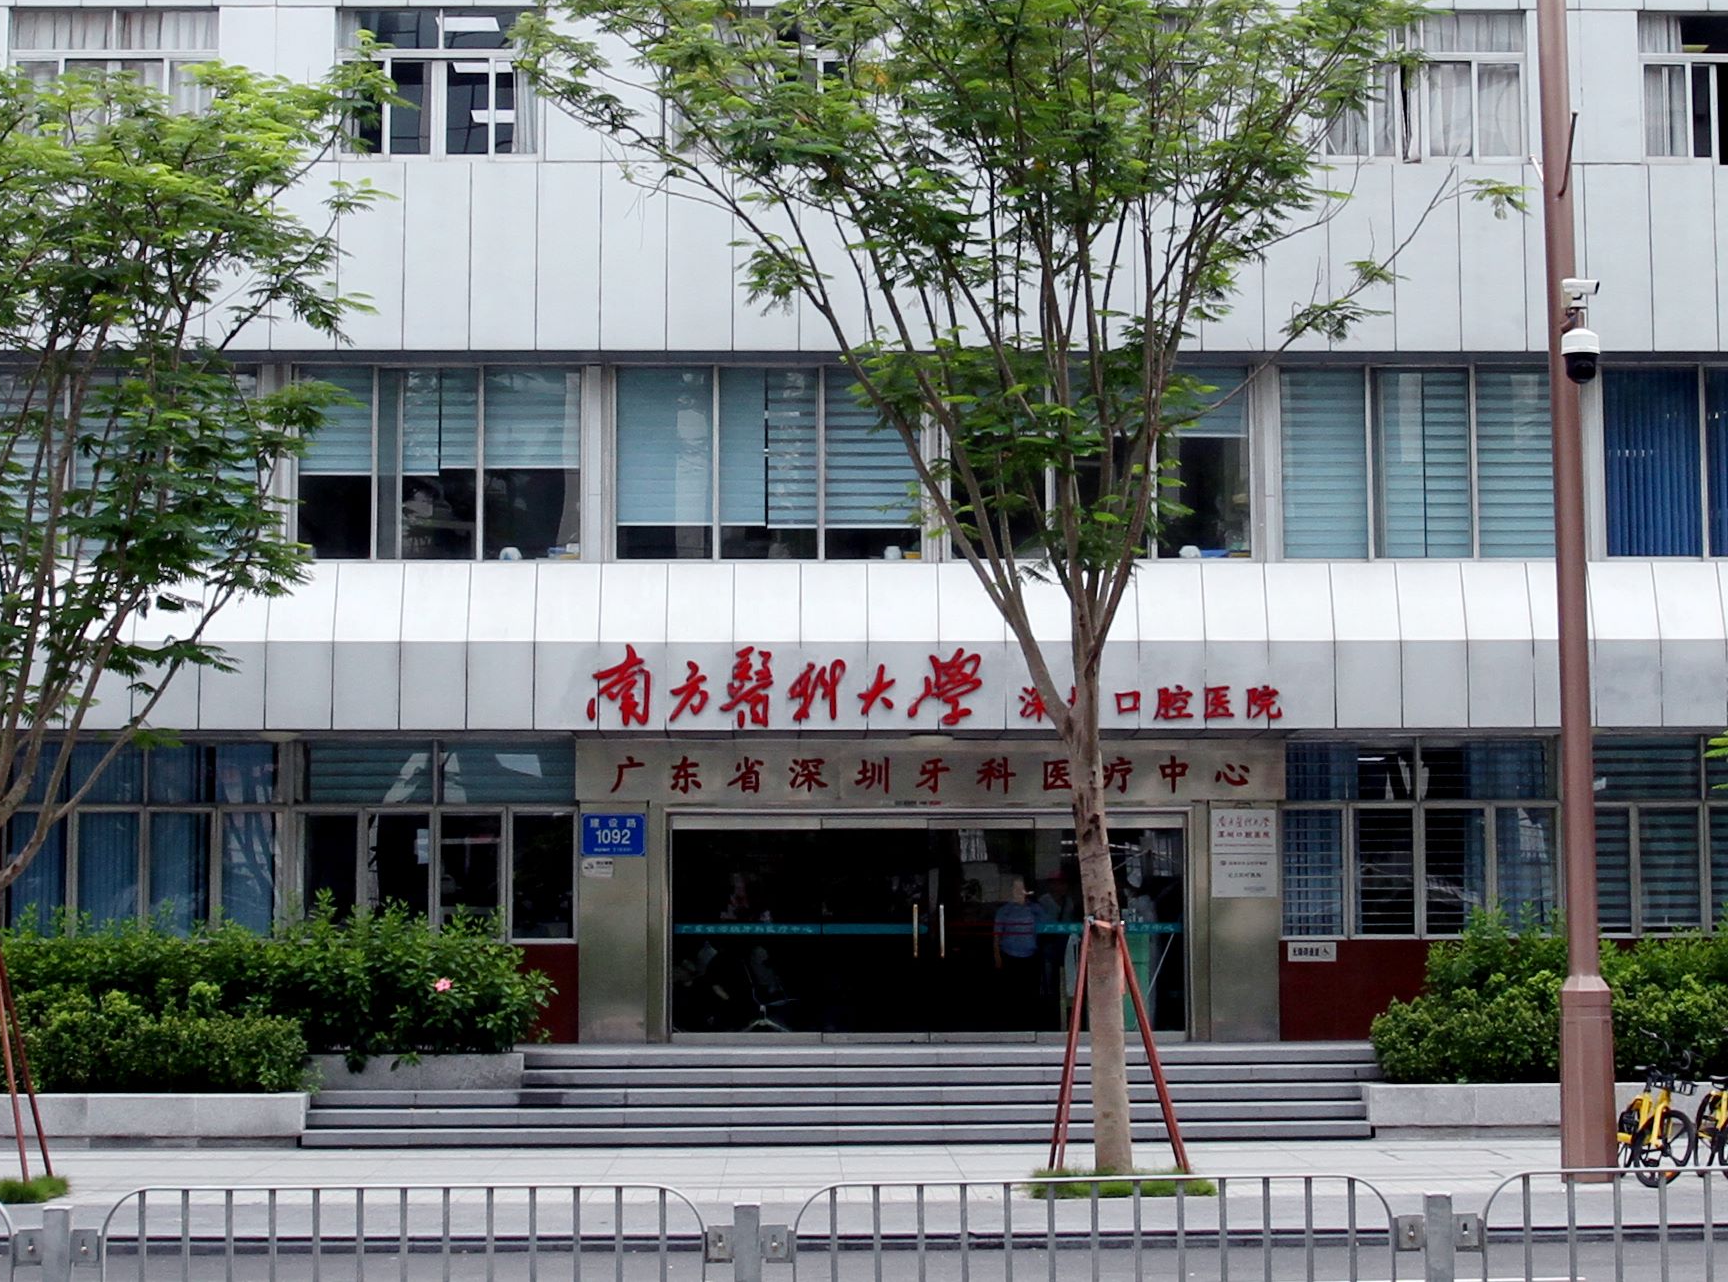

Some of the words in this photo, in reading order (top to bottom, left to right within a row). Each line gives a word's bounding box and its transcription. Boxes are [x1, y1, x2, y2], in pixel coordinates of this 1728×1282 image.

[1017, 684, 1284, 723] 深口腔医院
[609, 754, 1252, 796] 广东省深圳牙科医疗中心
[595, 829, 632, 845] 1092
